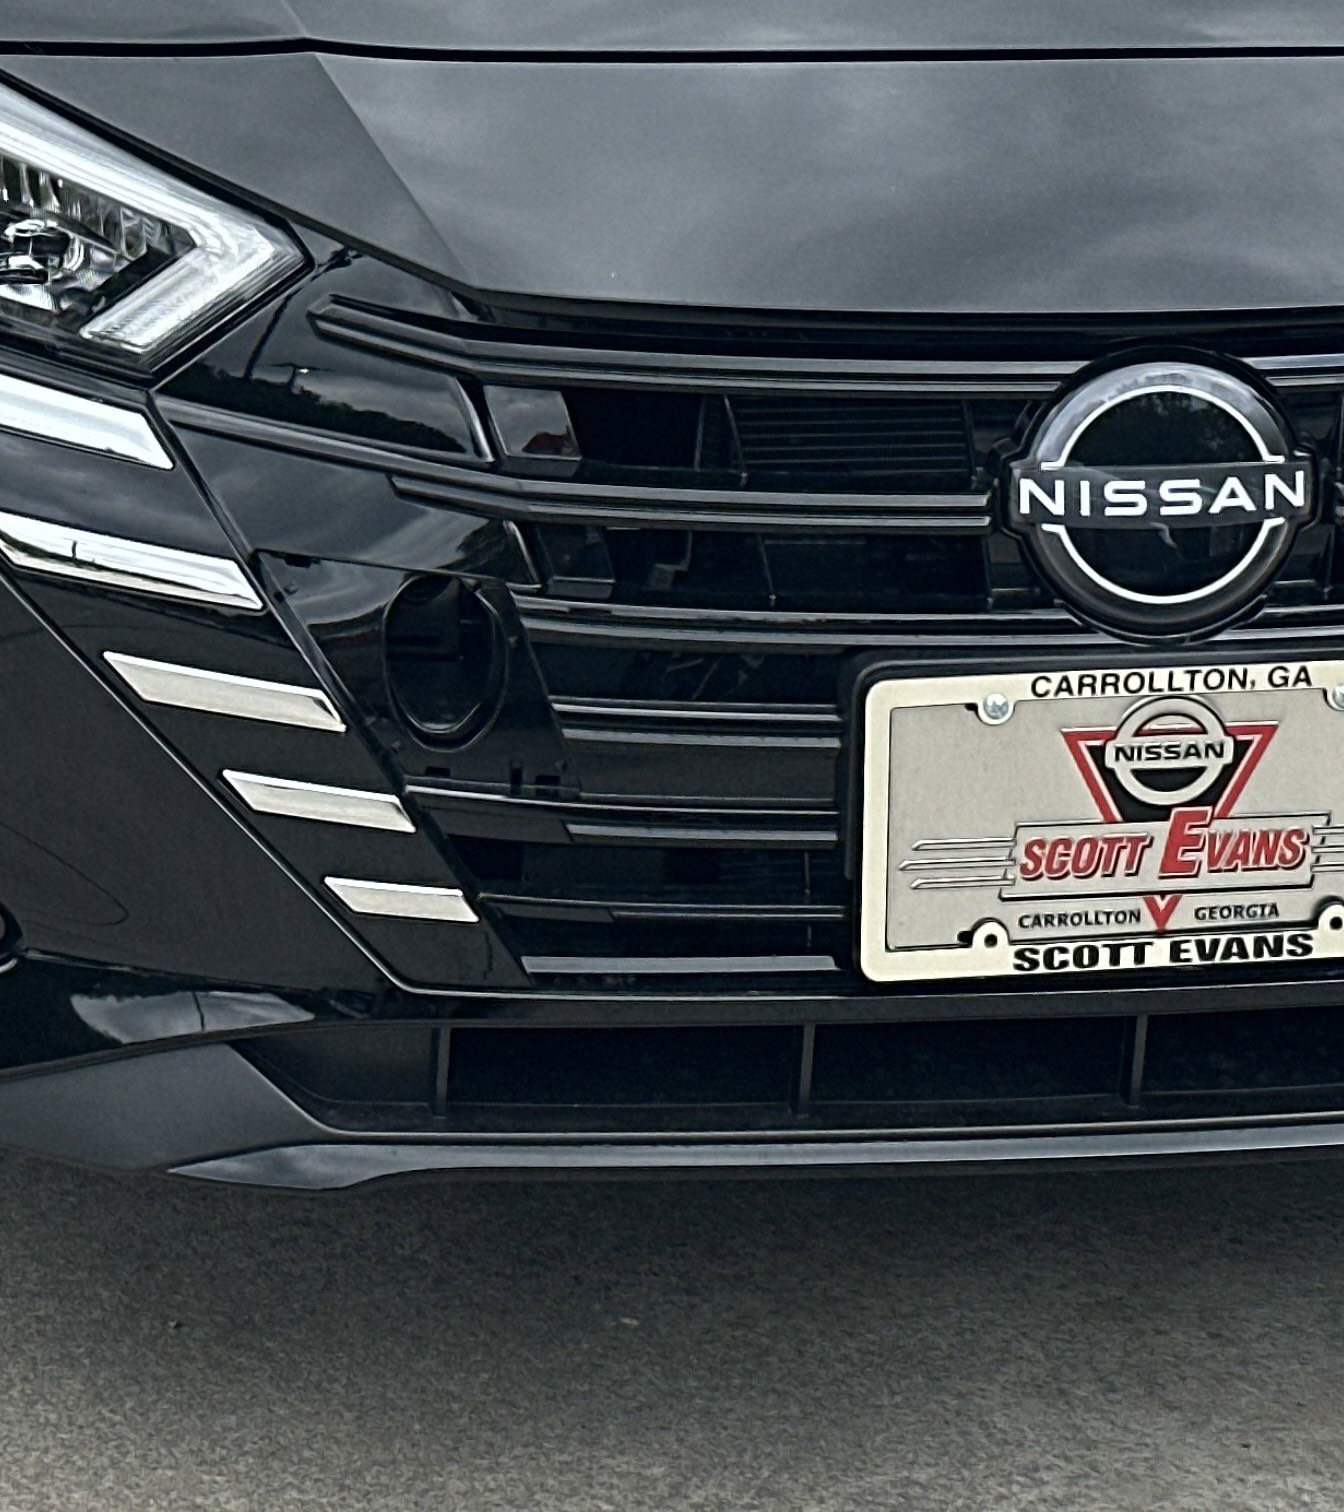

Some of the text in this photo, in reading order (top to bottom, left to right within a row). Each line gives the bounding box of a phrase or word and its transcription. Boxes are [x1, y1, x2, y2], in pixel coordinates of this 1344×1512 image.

[1019, 470, 1305, 517] NISSAN
[1030, 665, 1313, 699] CARROLLTON, GA
[1114, 740, 1226, 763] NISSAN
[1019, 806, 1312, 882] SCOTT EVANS
[1017, 902, 1280, 930] CARROLLTON GEORGIA
[1013, 932, 1314, 973] SCOTT EVANS
